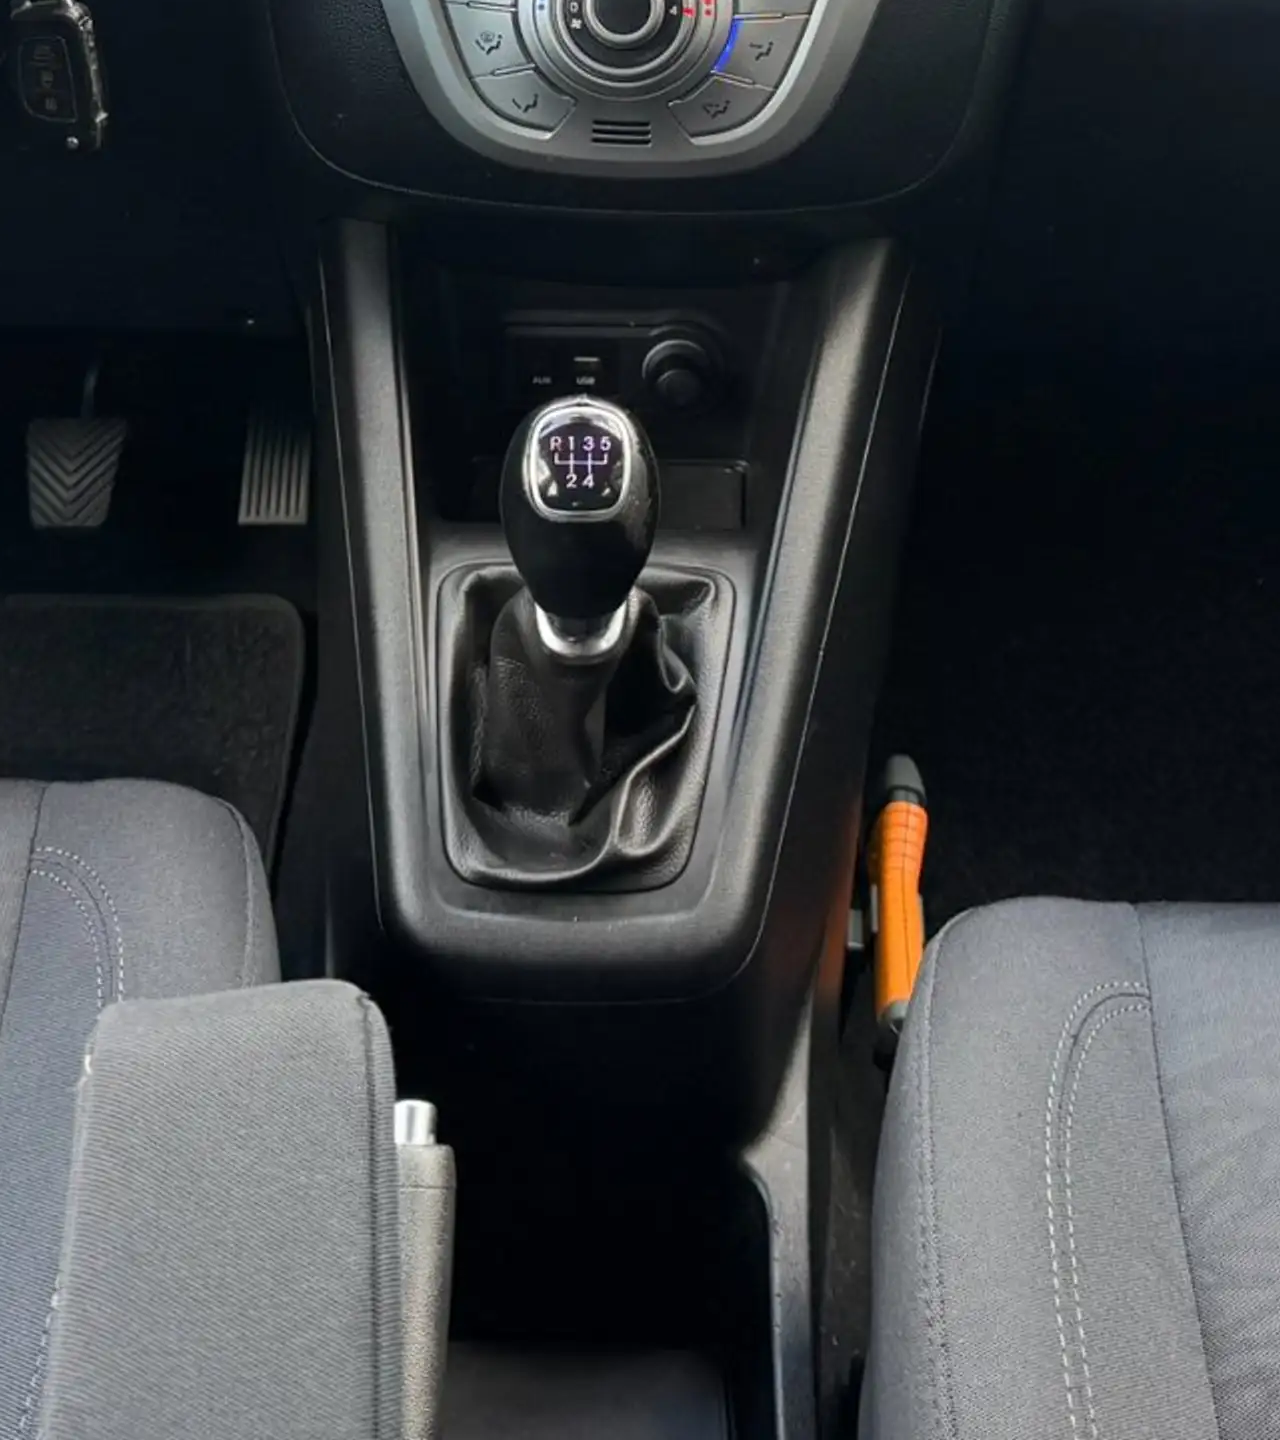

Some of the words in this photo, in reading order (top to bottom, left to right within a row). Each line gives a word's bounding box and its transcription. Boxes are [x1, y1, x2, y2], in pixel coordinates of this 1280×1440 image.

[669, 6, 678, 15] 4
[576, 376, 596, 385] USB
[550, 436, 562, 451] R
[568, 436, 575, 450] 1
[582, 436, 594, 450] 3
[600, 436, 612, 451] 5
[566, 474, 577, 488] 2
[582, 474, 595, 488] 4
